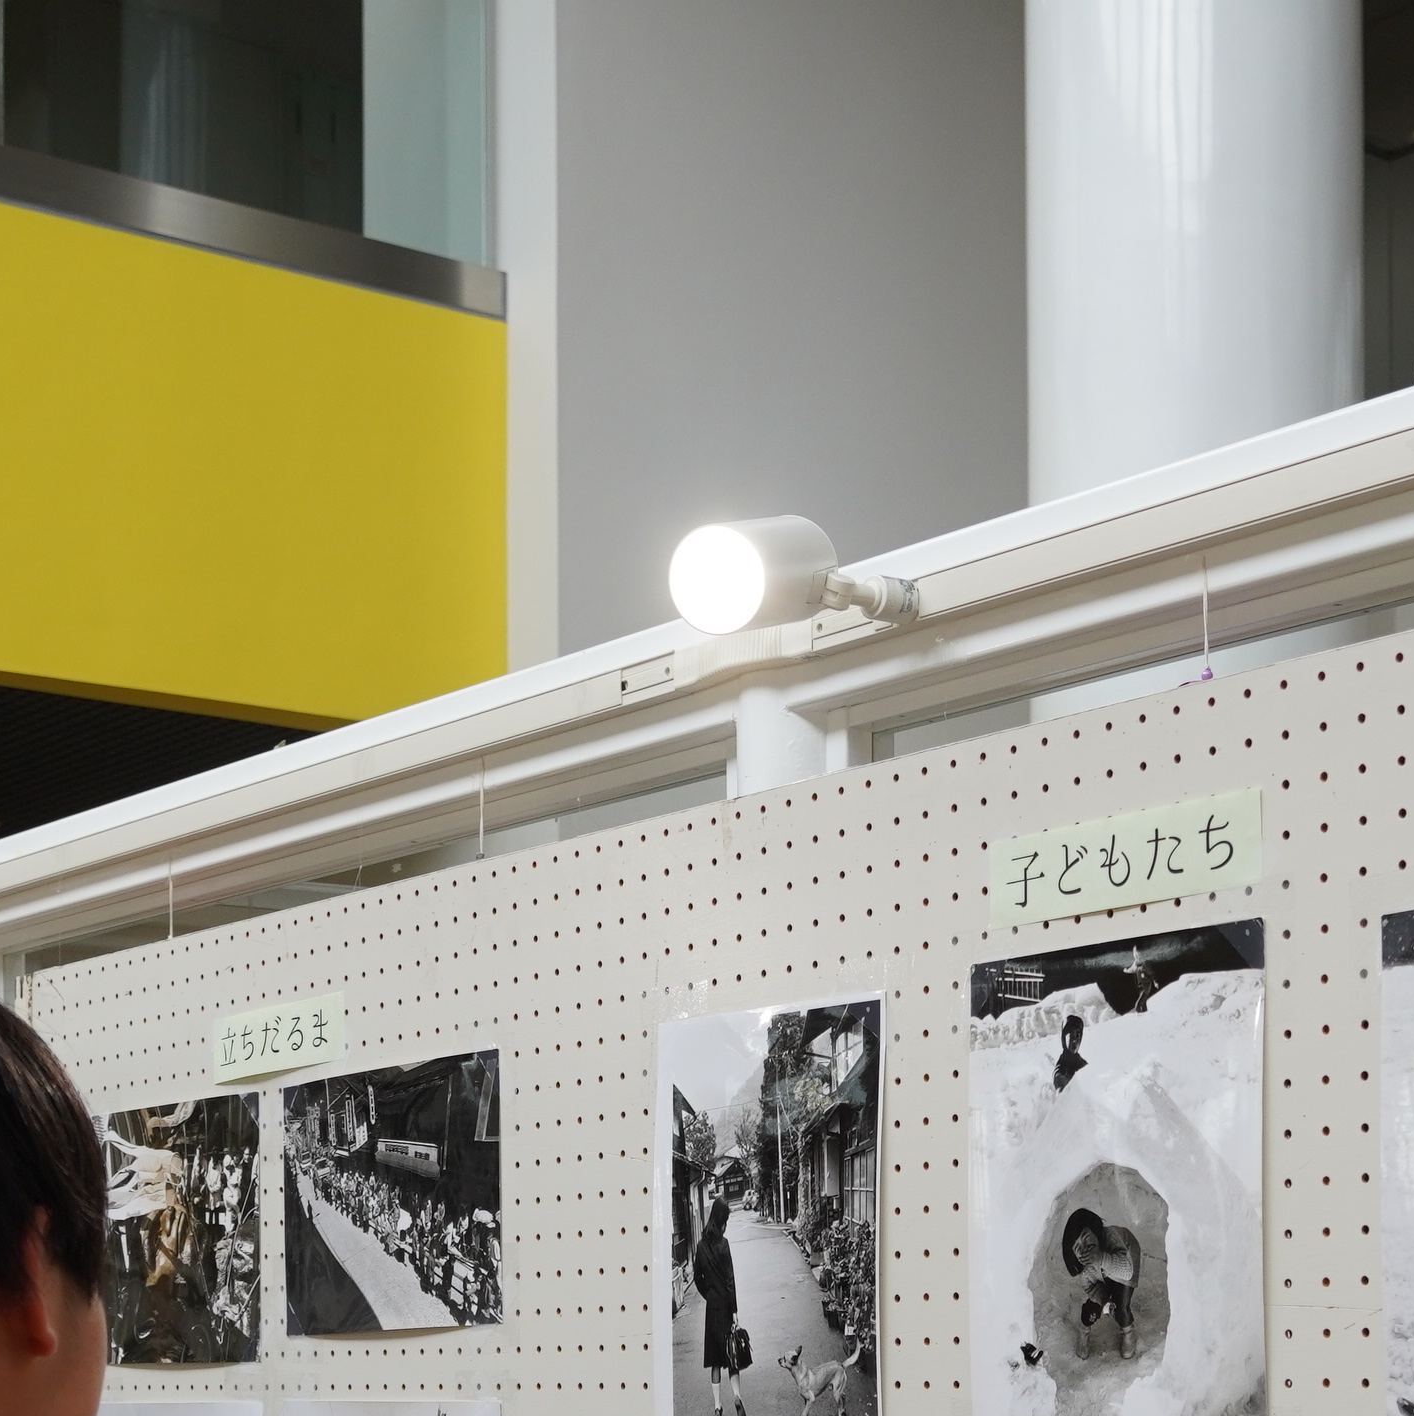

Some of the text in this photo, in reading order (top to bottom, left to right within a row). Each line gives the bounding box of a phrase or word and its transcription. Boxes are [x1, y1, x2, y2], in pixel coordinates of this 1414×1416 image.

[1006, 814, 1235, 909] 子どもたち
[219, 1008, 329, 1067] 立ちだるま
